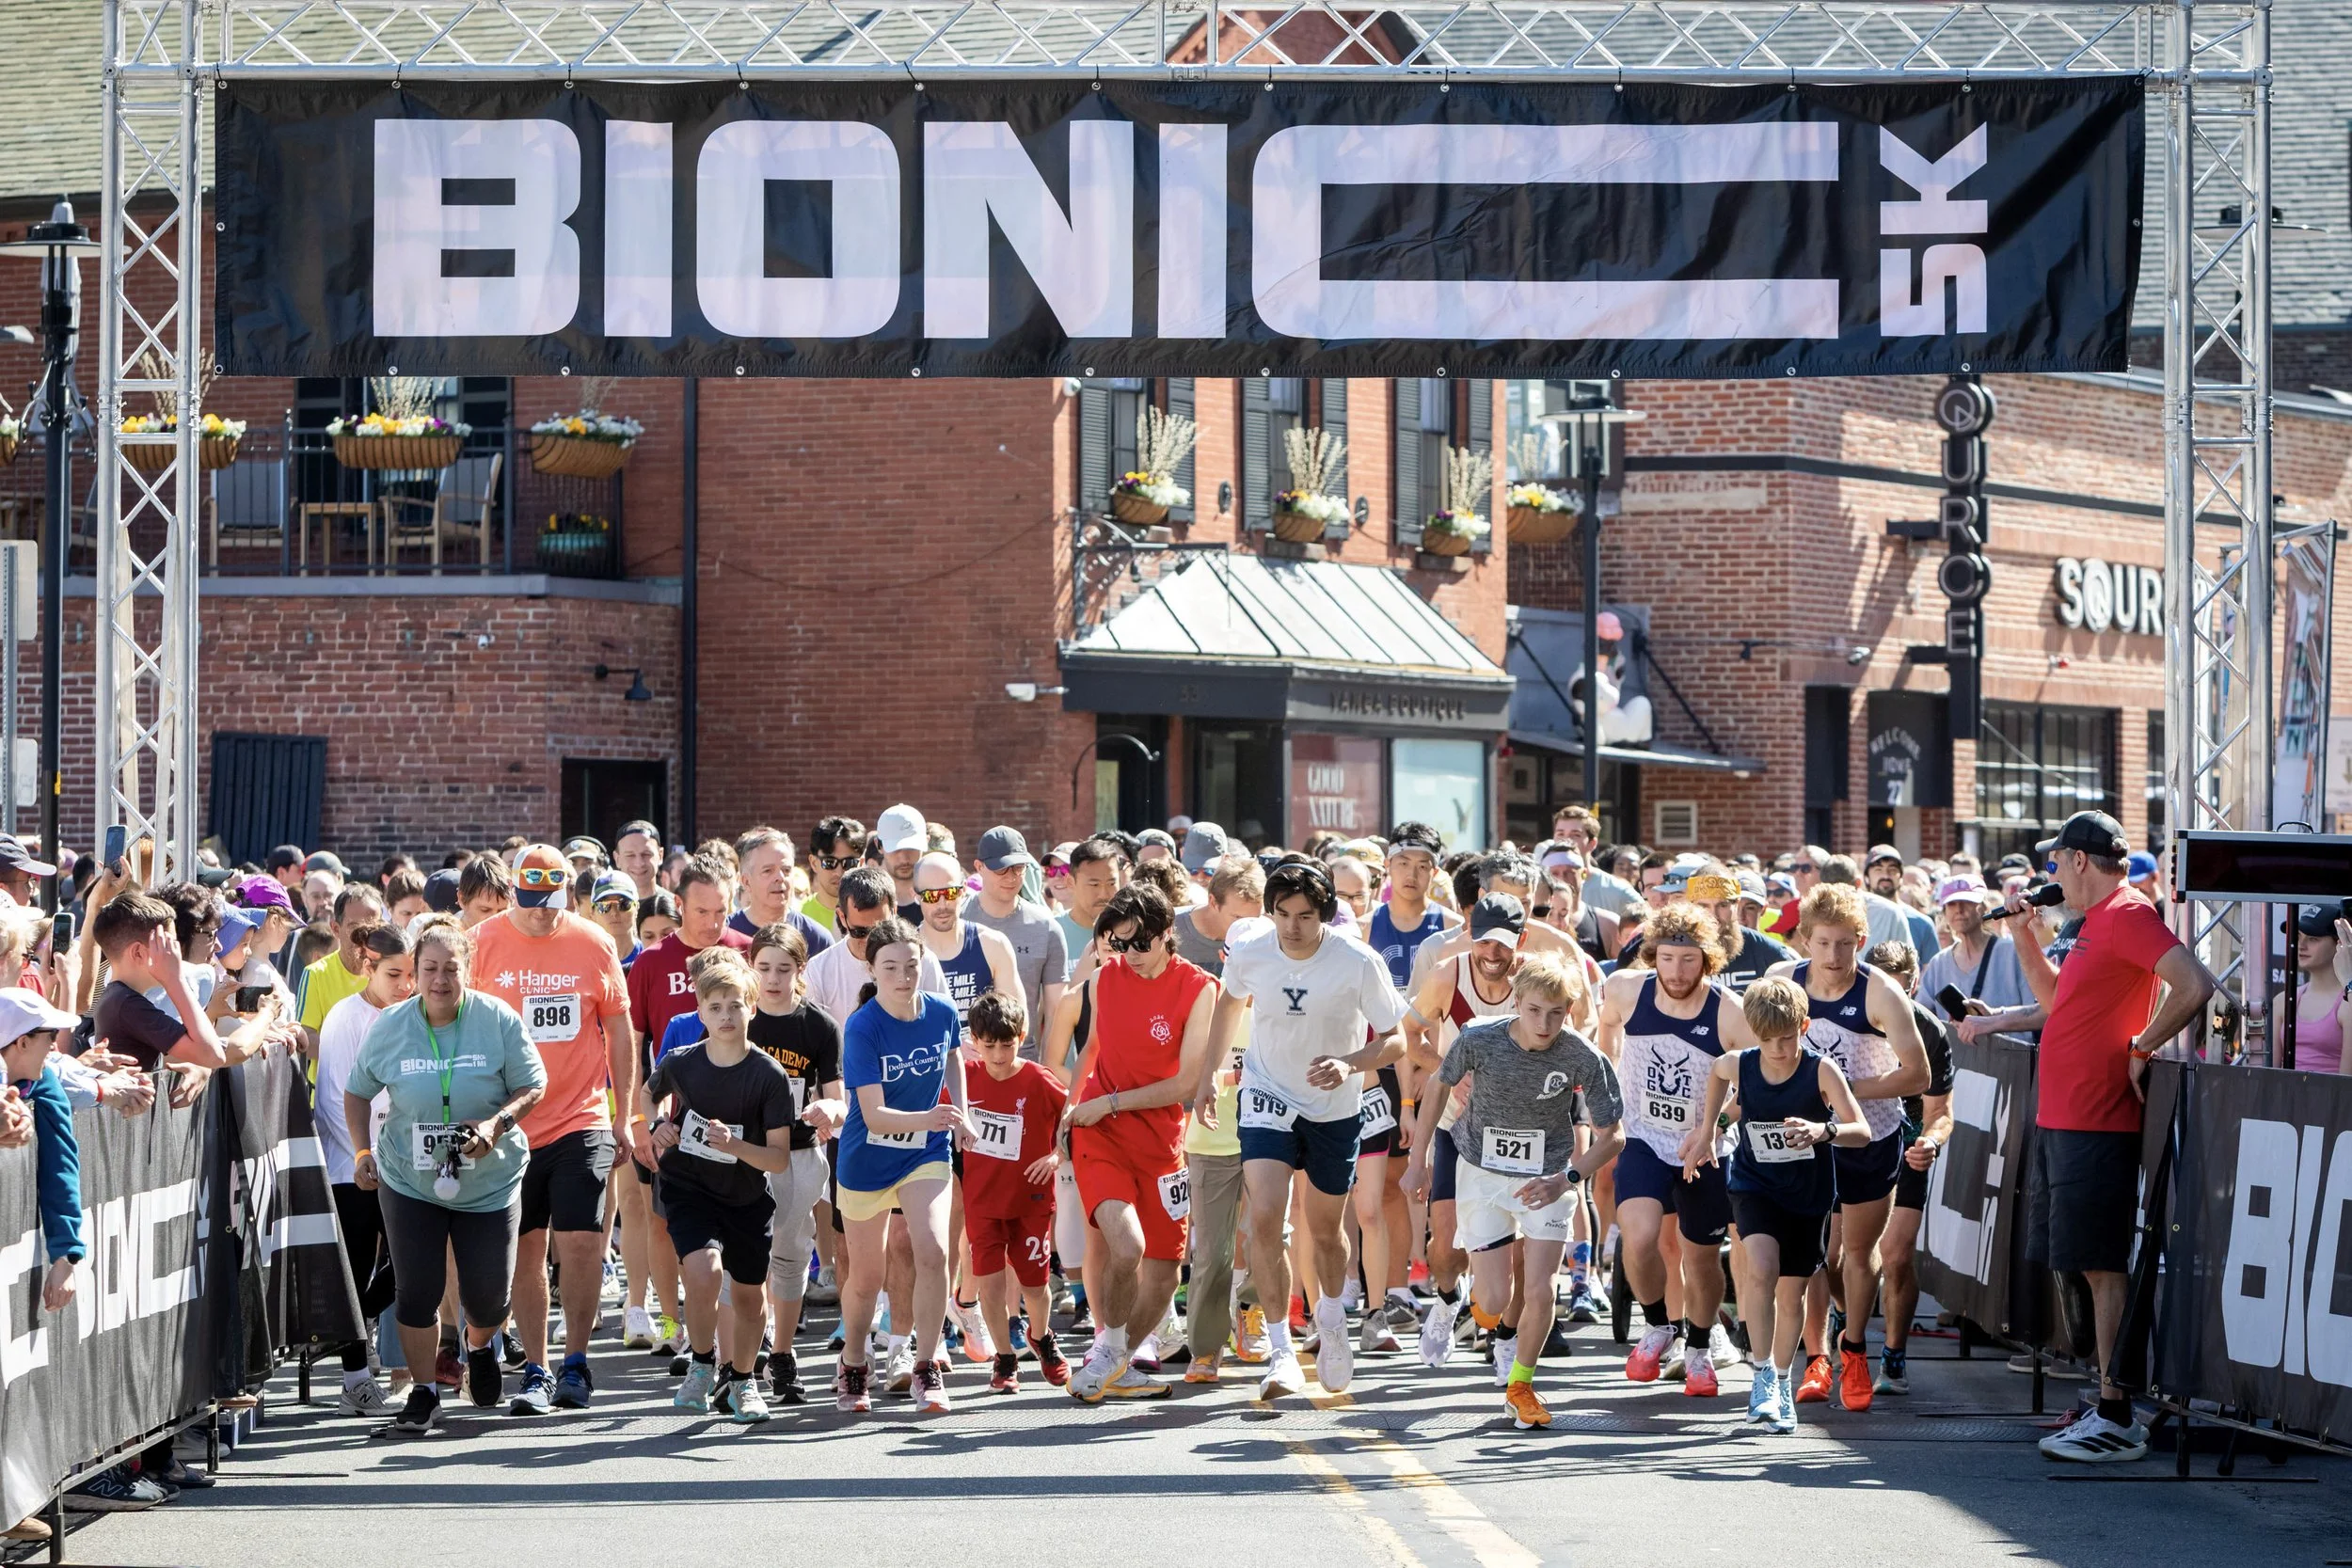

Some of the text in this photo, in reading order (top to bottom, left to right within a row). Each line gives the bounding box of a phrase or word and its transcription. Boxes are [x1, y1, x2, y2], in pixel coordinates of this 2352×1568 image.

[372, 119, 1988, 341] BIONIC 5K
[1934, 382, 1981, 656] OURCE
[2057, 557, 2164, 636] SOUR
[518, 969, 581, 991] Hanger
[953, 973, 977, 988] MILE
[529, 995, 568, 1004] BIONIC
[954, 985, 977, 999] MILE
[1282, 987, 1309, 1011] Y
[532, 1005, 571, 1027] 898
[888, 1045, 940, 1072] Dedham Country
[1252, 1096, 1288, 1117] 919
[1645, 1091, 1684, 1105] BIONIC
[691, 1113, 711, 1128] BION
[974, 1109, 1010, 1123] BIONIC
[1649, 1101, 1686, 1123] 639
[981, 1120, 1007, 1145] 771
[1489, 1128, 1532, 1138] BIONIC
[1495, 1138, 1532, 1161] 521
